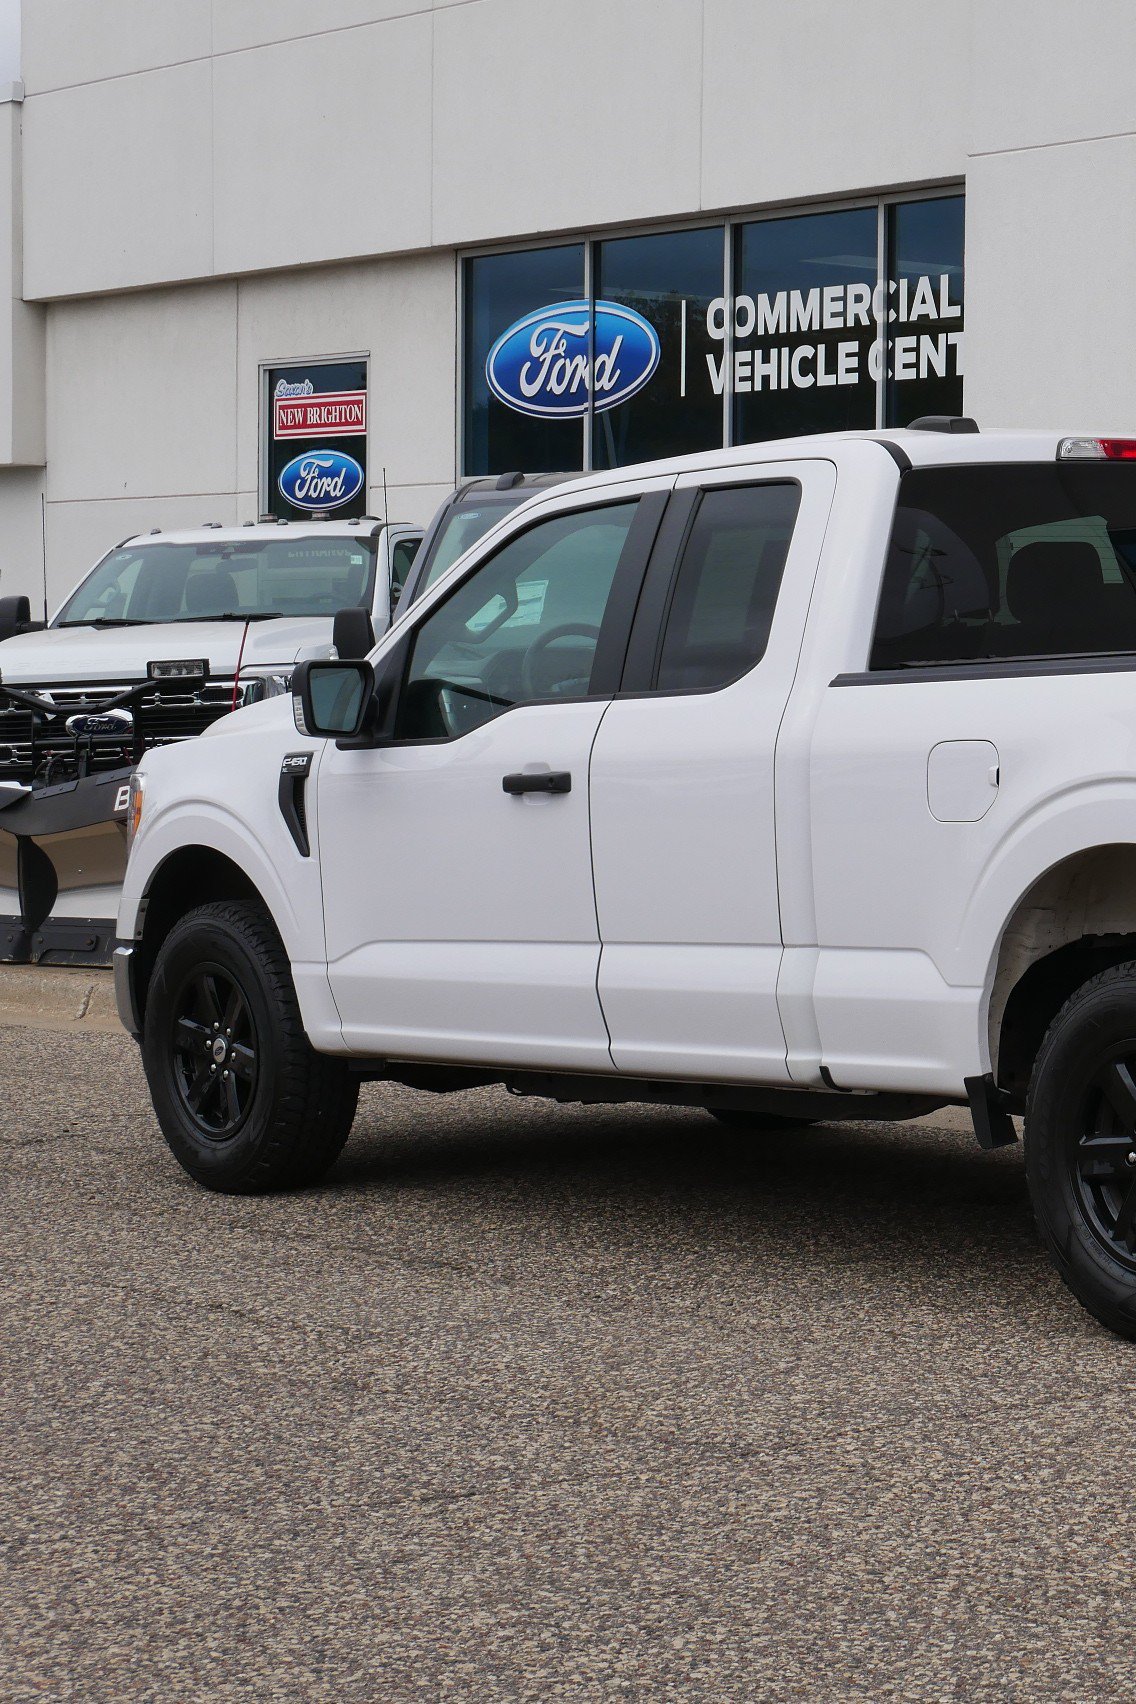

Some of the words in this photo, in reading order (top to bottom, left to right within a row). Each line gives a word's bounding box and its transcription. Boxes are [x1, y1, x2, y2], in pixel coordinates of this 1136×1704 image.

[706, 274, 962, 340] COMMERCIAL
[519, 320, 624, 398] Ford
[706, 341, 859, 395] VEHICLE
[279, 408, 305, 426] NEW
[306, 404, 363, 425] BRIGHTON
[295, 458, 347, 499] Ford
[84, 717, 117, 731] Ford
